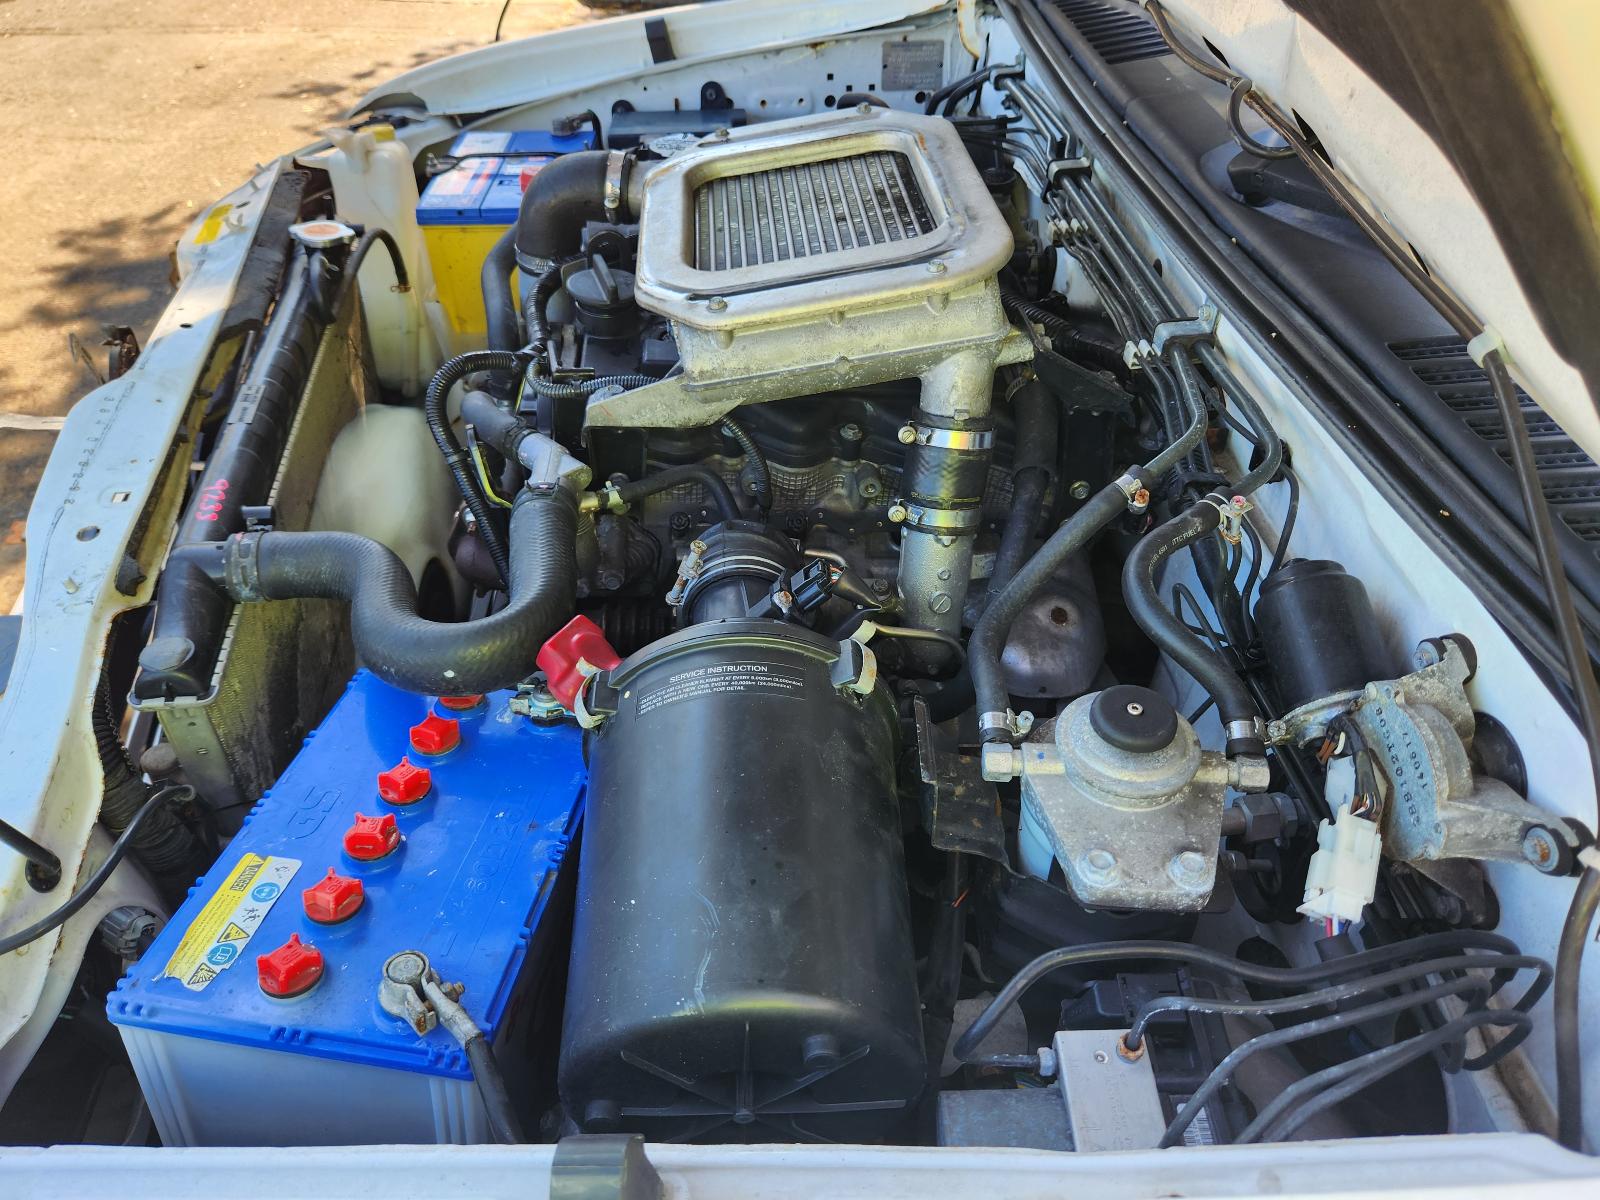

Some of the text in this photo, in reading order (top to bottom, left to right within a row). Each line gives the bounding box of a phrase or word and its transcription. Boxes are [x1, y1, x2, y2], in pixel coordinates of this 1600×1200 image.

[669, 665, 768, 683] SERVICE INSTRUCTION
[682, 685, 696, 693] NEW
